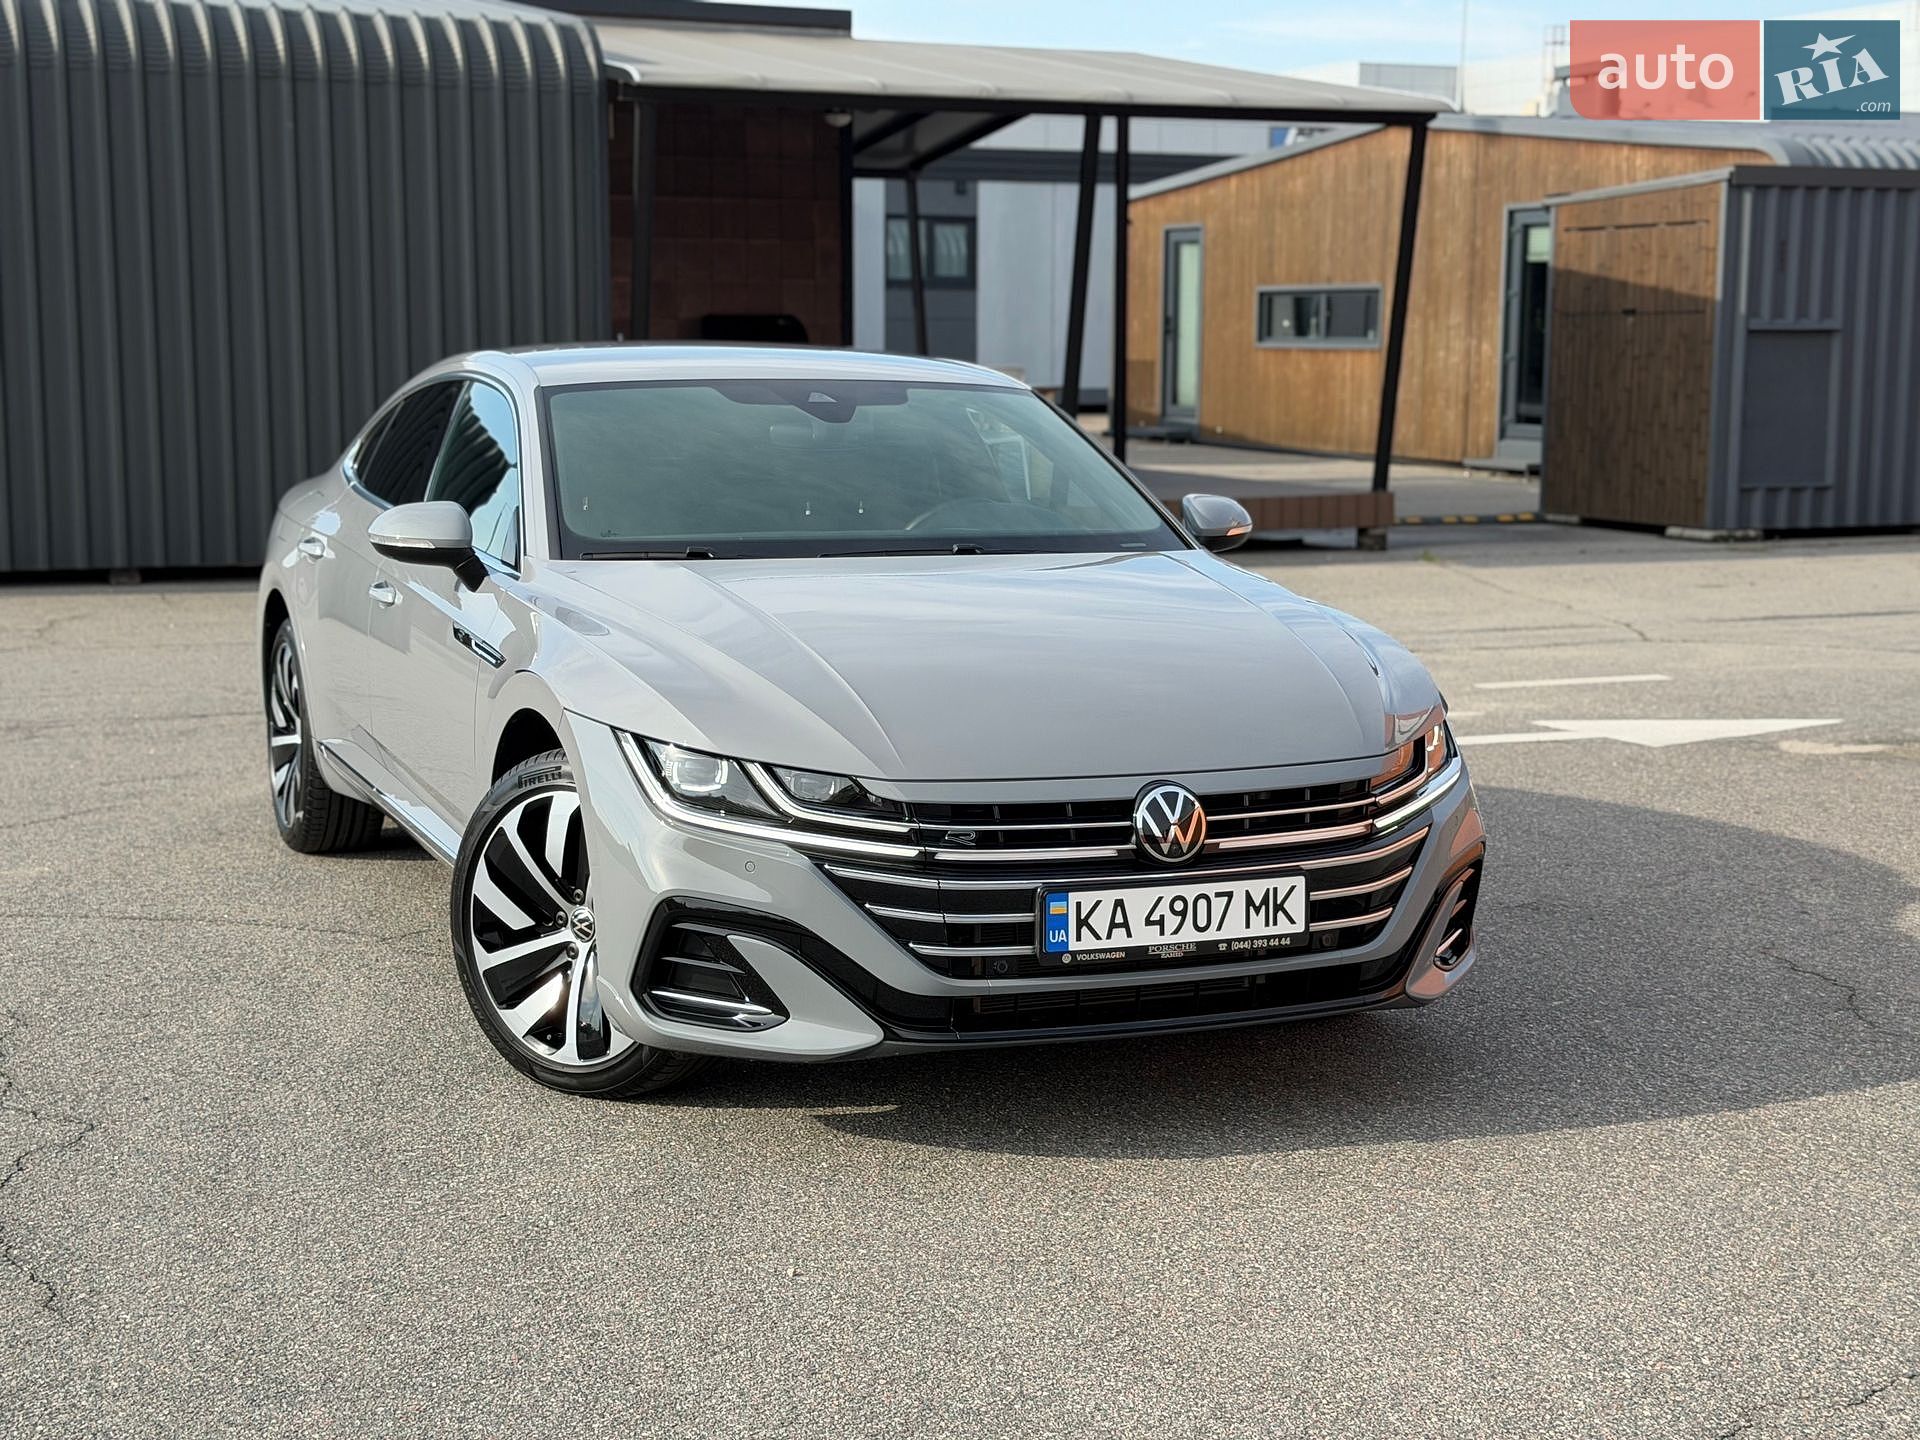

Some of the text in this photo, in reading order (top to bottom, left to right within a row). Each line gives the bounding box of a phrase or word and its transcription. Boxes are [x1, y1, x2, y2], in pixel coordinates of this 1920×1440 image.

[518, 765, 562, 789] PIRELLI
[1075, 884, 1297, 942] KA 4907 MK
[1049, 929, 1068, 943] UA
[1148, 943, 1197, 953] PORSCHE
[1231, 936, 1291, 951] (044) 393 44 44
[1076, 951, 1126, 961] VOLKSWAGEN
